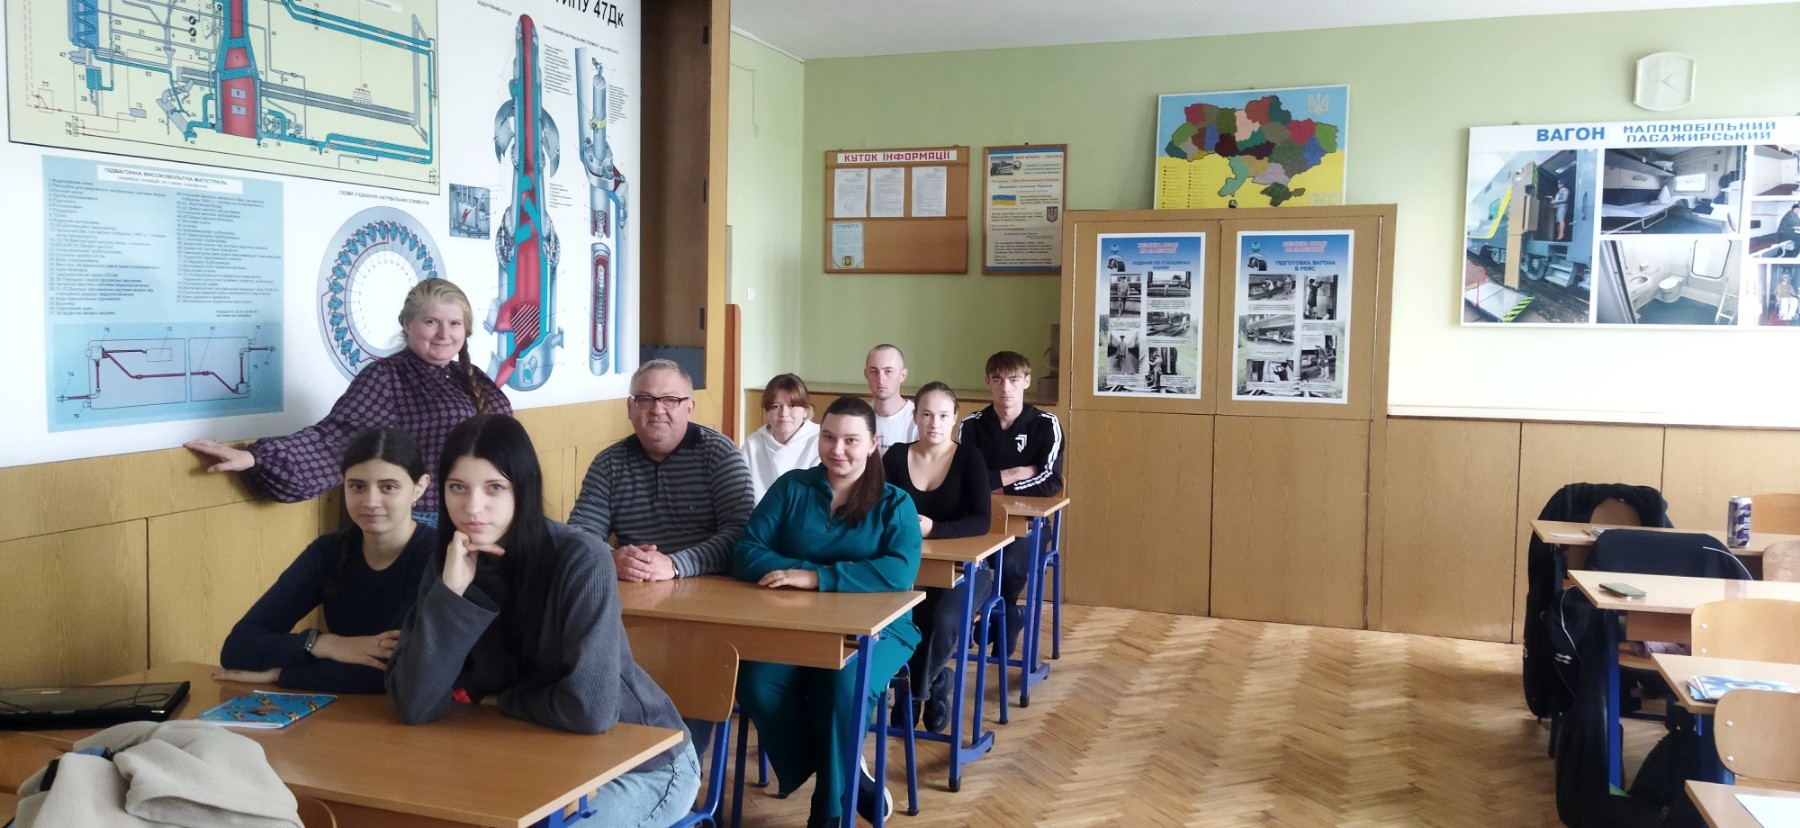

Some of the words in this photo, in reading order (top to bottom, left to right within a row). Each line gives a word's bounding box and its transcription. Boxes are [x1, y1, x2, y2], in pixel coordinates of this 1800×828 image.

[593, 0, 625, 28] 47Дк
[1536, 127, 1605, 142] ВАГОН
[1623, 121, 1776, 133] МАЛОМОБІЛЬНИЙ
[844, 153, 878, 162] КУТОК
